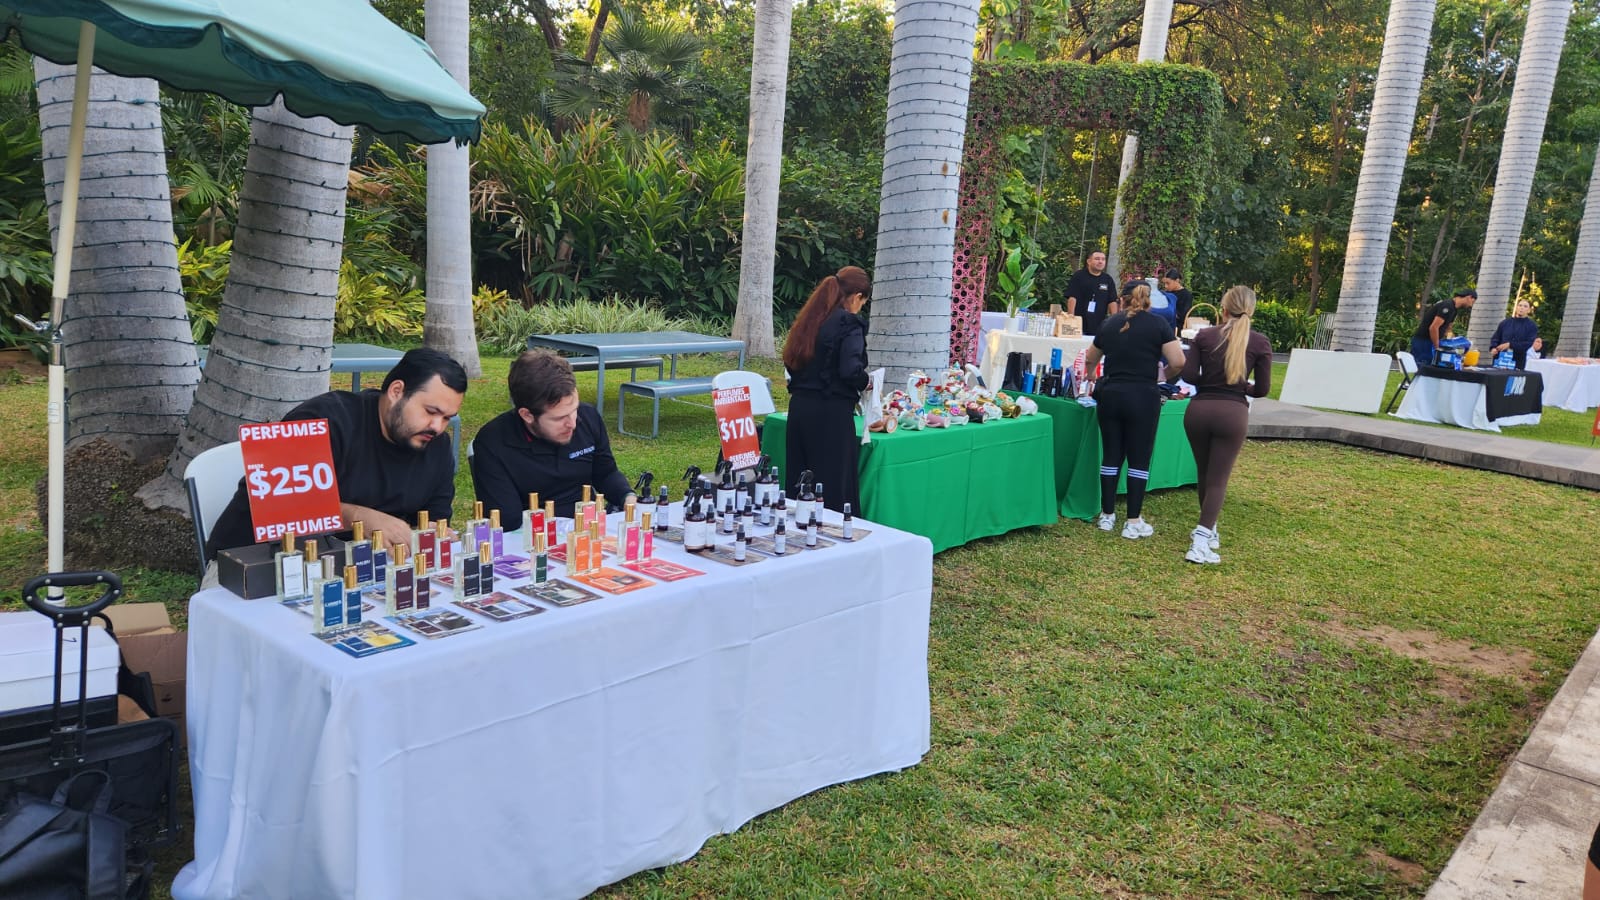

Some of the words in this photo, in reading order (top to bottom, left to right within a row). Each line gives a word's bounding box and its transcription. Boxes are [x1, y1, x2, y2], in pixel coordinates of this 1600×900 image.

[240, 421, 328, 441] PERFUMES
[720, 416, 755, 442] $170
[248, 462, 334, 500] $250
[255, 515, 342, 540] PERFUMES
